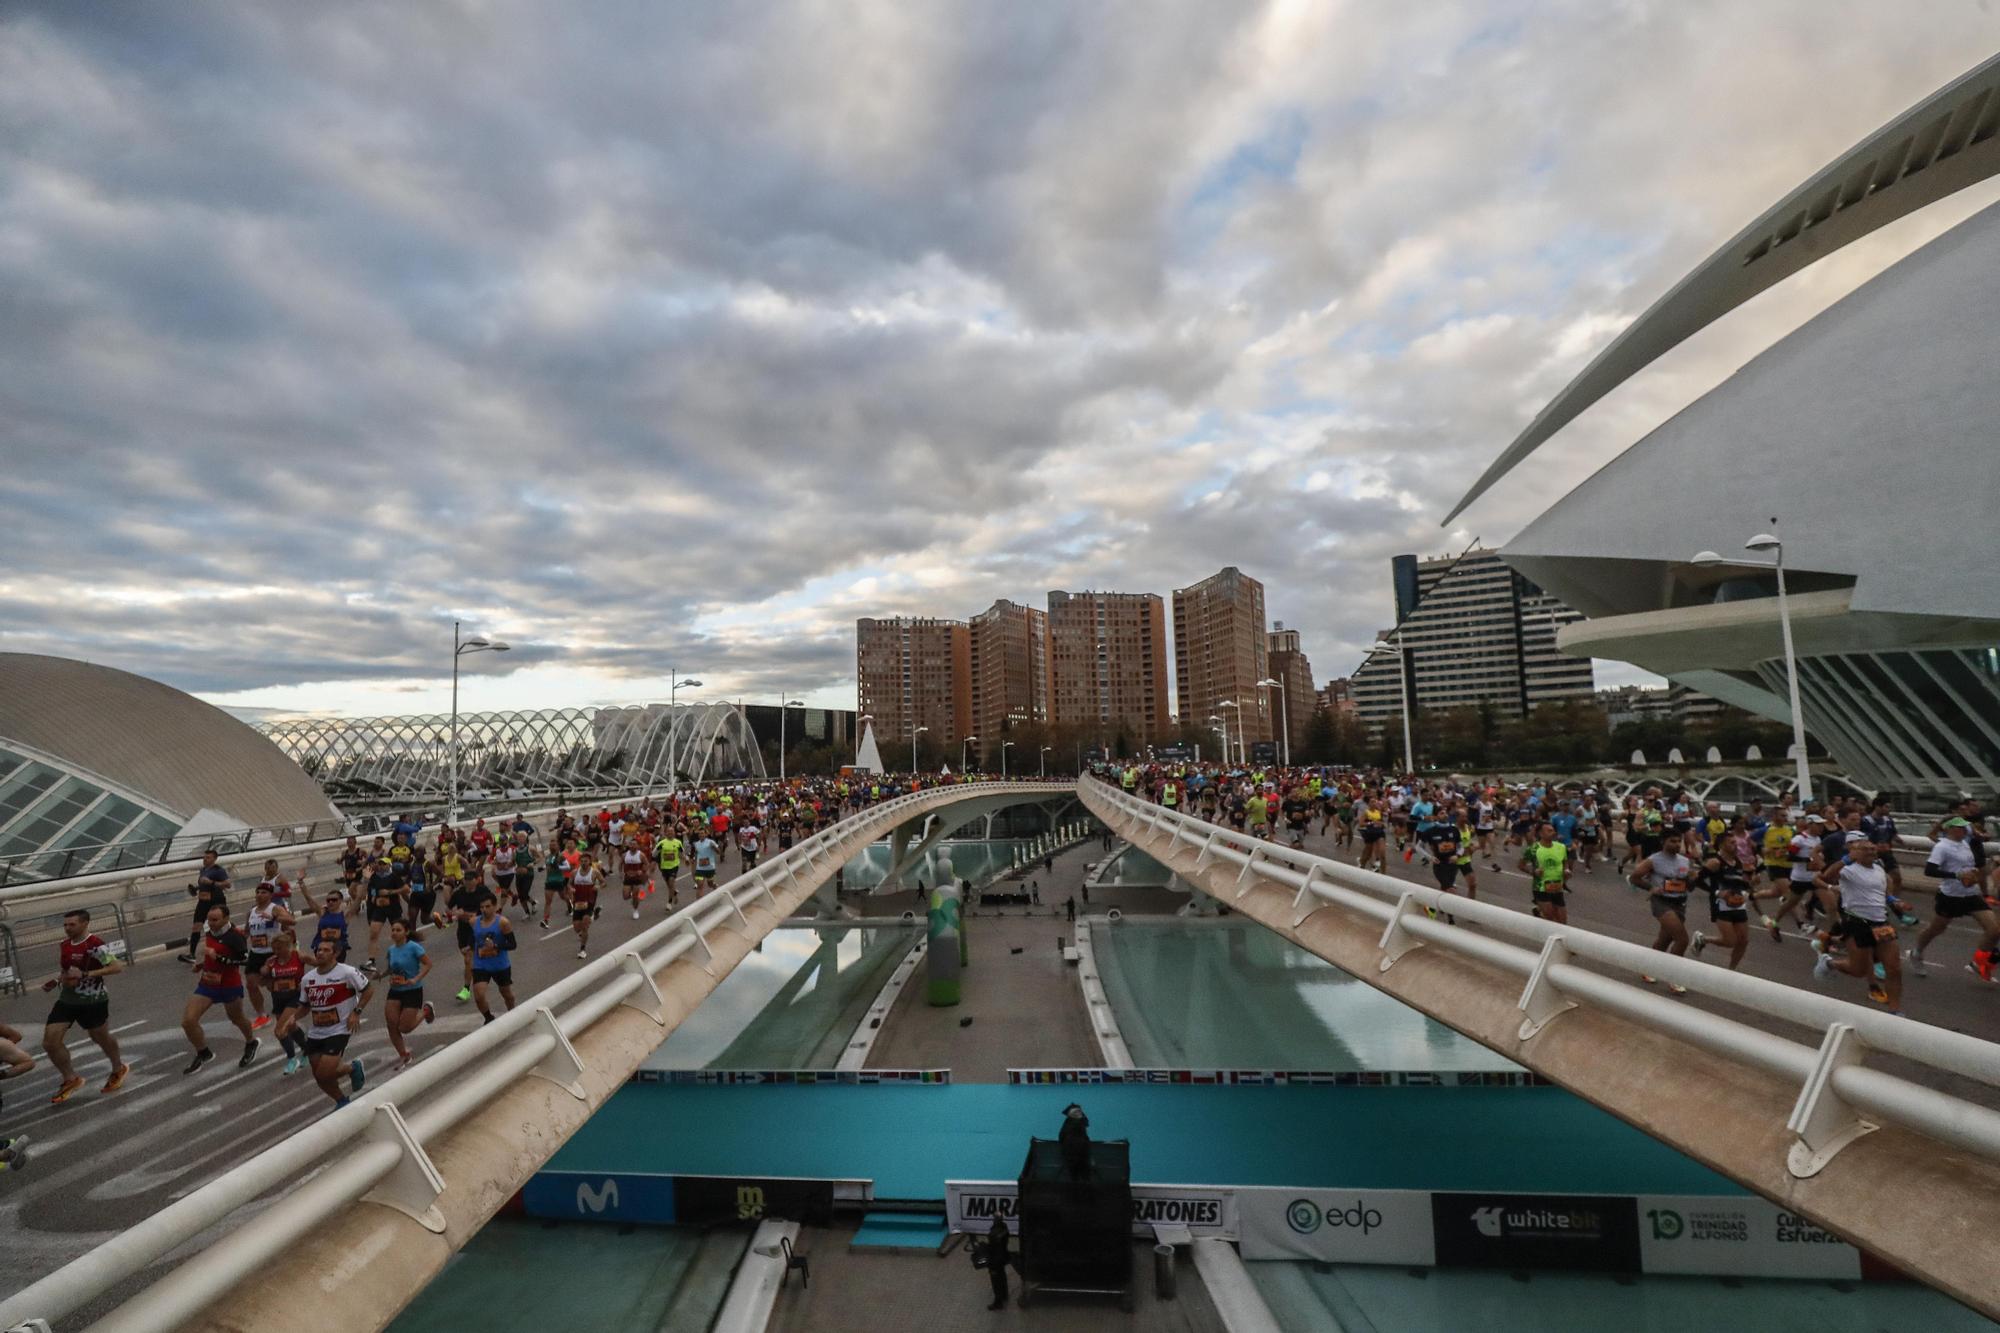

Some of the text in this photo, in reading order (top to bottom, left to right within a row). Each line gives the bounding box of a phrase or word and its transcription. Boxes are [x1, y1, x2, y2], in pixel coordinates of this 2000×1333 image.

[1326, 1200, 1382, 1235] edp
[1690, 1220, 1748, 1231] TRINIDAD
[1691, 1231, 1749, 1241] ALFONSO
